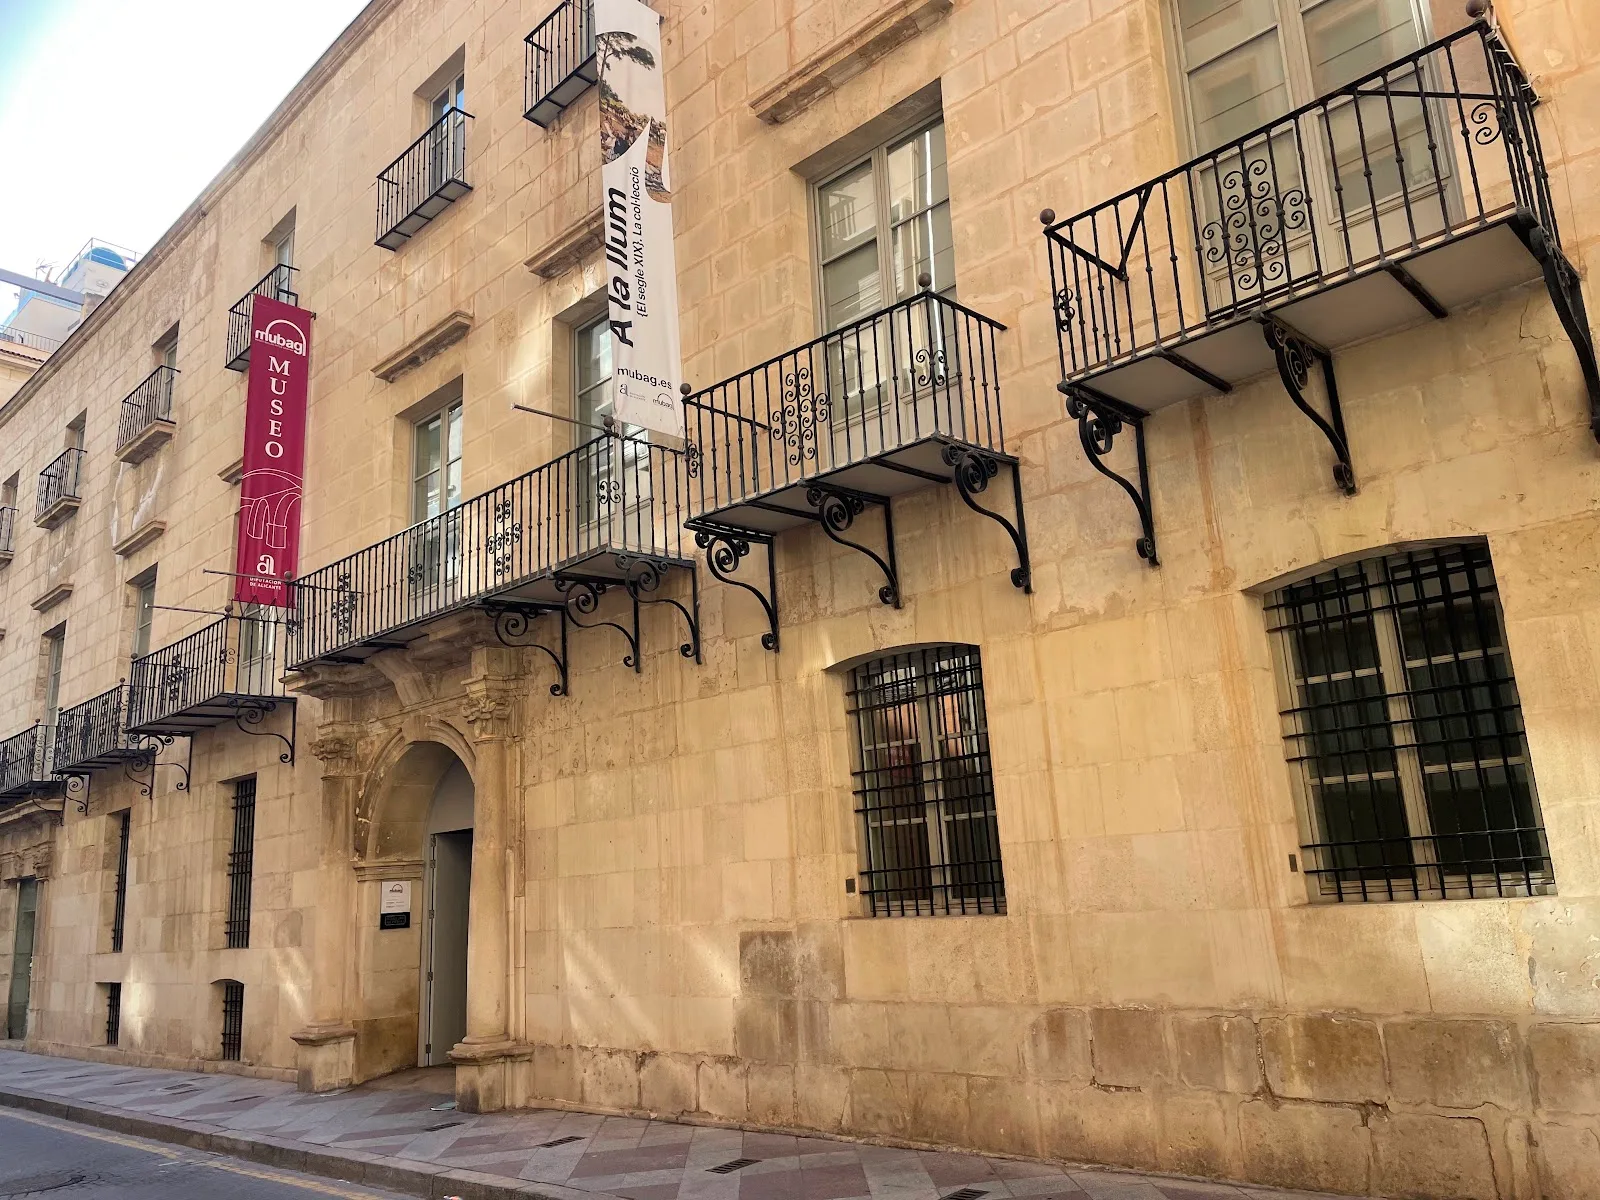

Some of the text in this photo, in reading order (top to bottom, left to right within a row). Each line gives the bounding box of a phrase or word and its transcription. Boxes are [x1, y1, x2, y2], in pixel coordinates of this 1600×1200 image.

[632, 222, 642, 235] La
[605, 187, 634, 348] A la llum
[634, 269, 648, 301] segle
[255, 329, 304, 356] mubag
[617, 367, 672, 390] mubag.es
[264, 355, 291, 459] MUSEO
